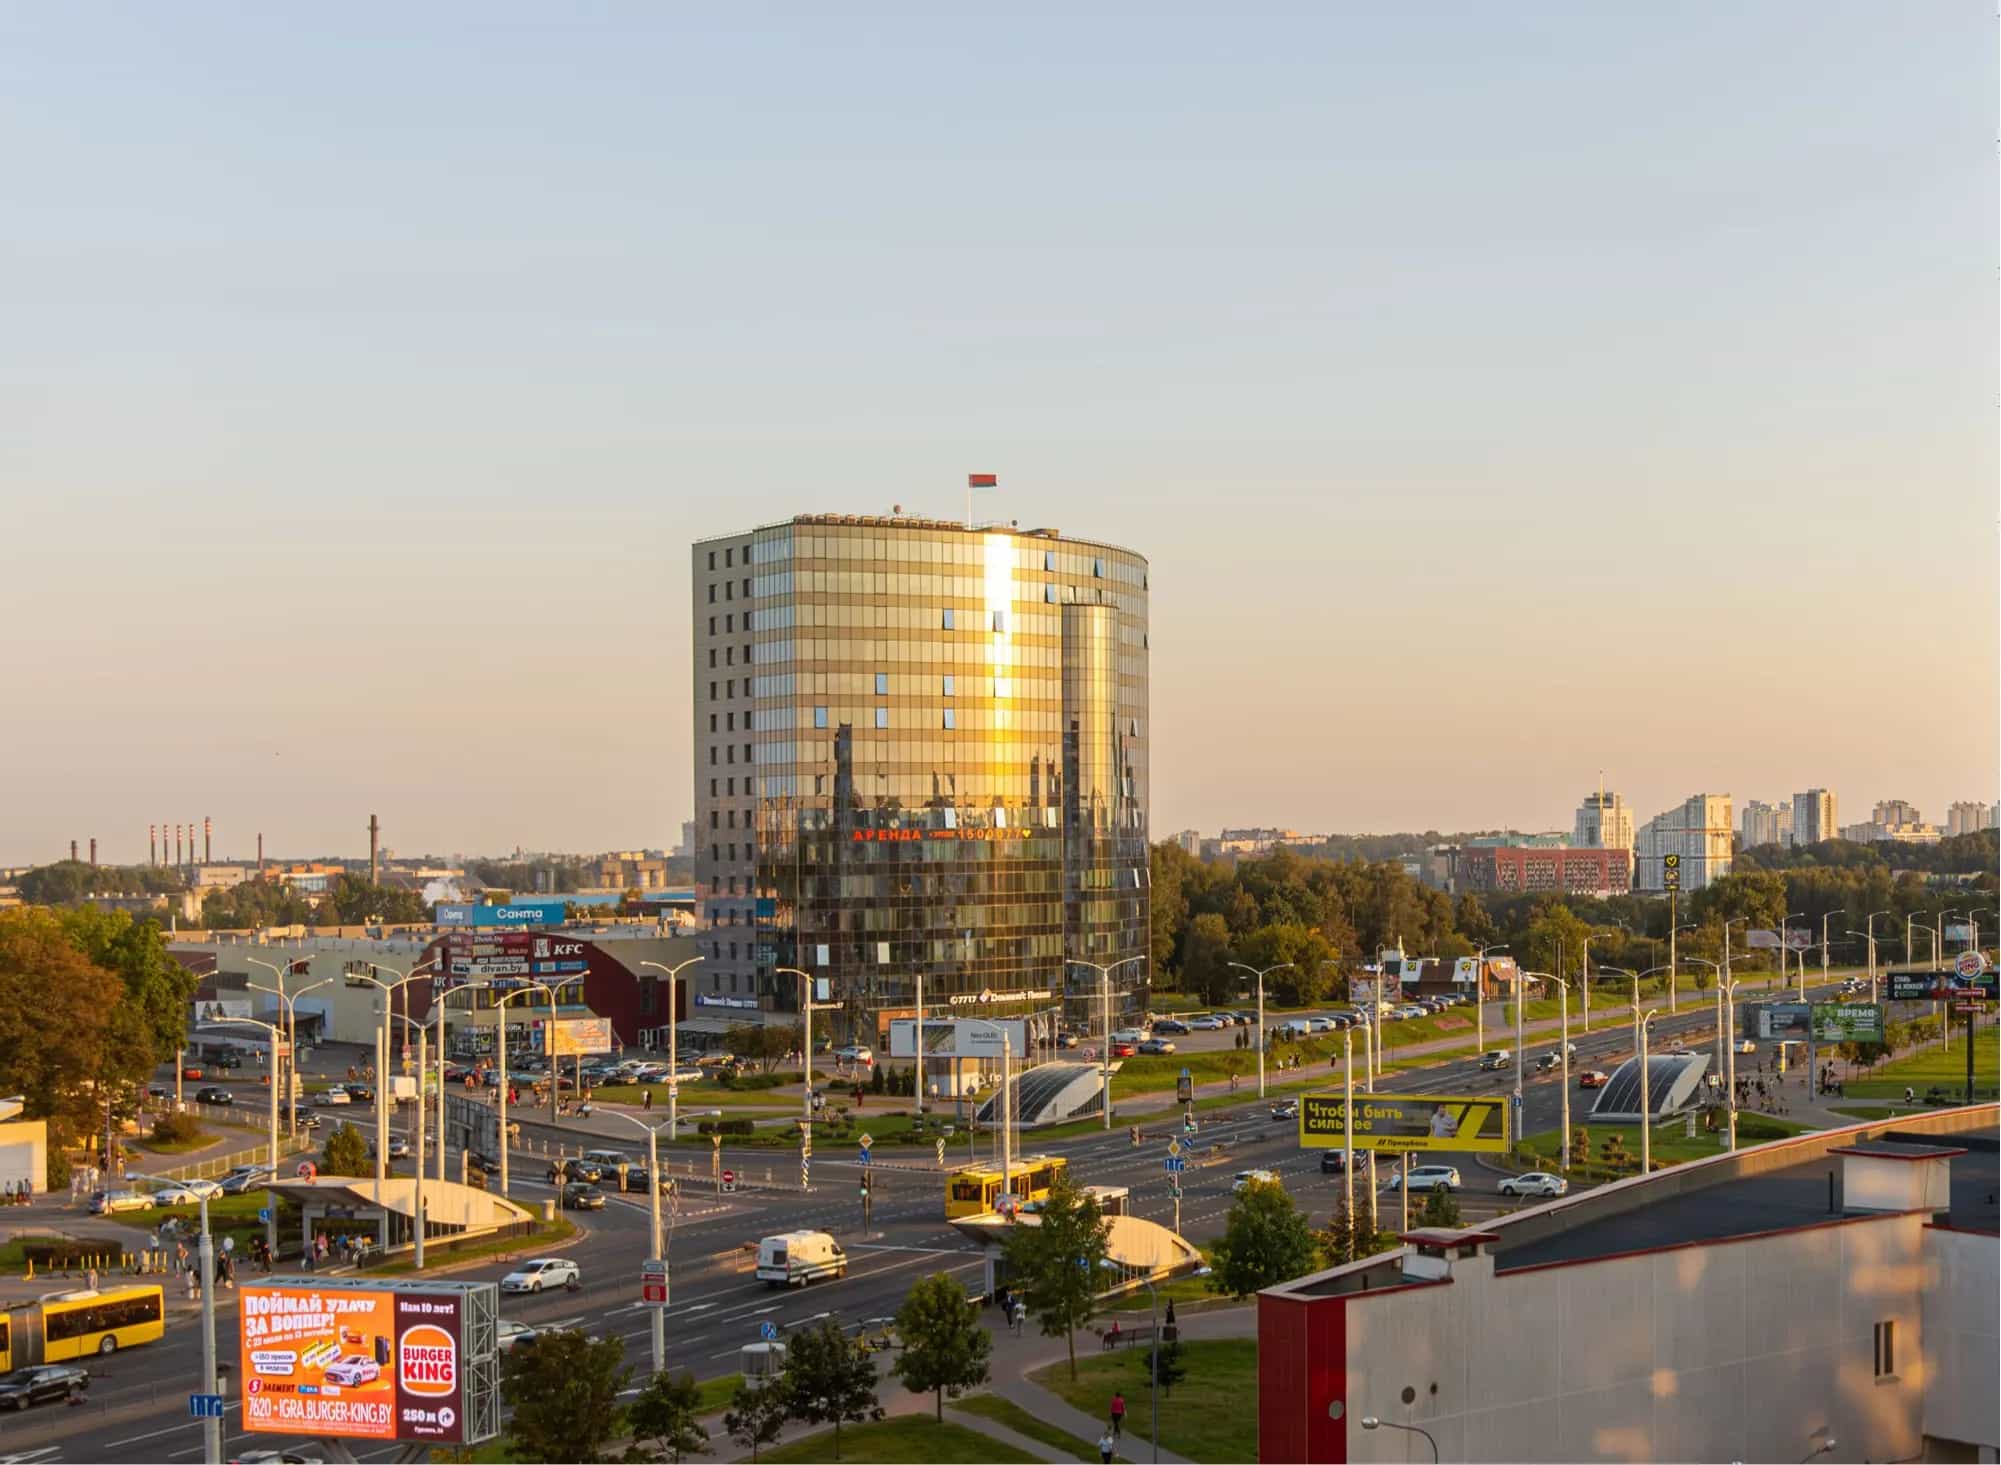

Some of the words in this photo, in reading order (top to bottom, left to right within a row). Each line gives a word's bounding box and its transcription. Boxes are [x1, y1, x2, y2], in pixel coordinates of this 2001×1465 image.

[854, 830, 921, 841] АРЕНДА
[497, 908, 543, 920] Санта
[553, 943, 584, 955] KFC
[481, 964, 522, 974] divan.by
[1363, 1104, 1403, 1120] быть
[1308, 1118, 1373, 1131] сильее
[245, 1292, 322, 1315] ПОЙМАЙ
[400, 1302, 420, 1313] Нам
[421, 1302, 432, 1313] 10
[433, 1303, 454, 1314] лет!
[245, 1316, 268, 1338] ЗА
[271, 1313, 335, 1333] ВОППЕР!
[403, 1347, 452, 1362] BURGER
[403, 1361, 453, 1381] KING
[247, 1396, 271, 1417] 7620
[279, 1399, 392, 1424] IGRA.BURGER-KING.BY
[403, 1408, 426, 1421] 250
